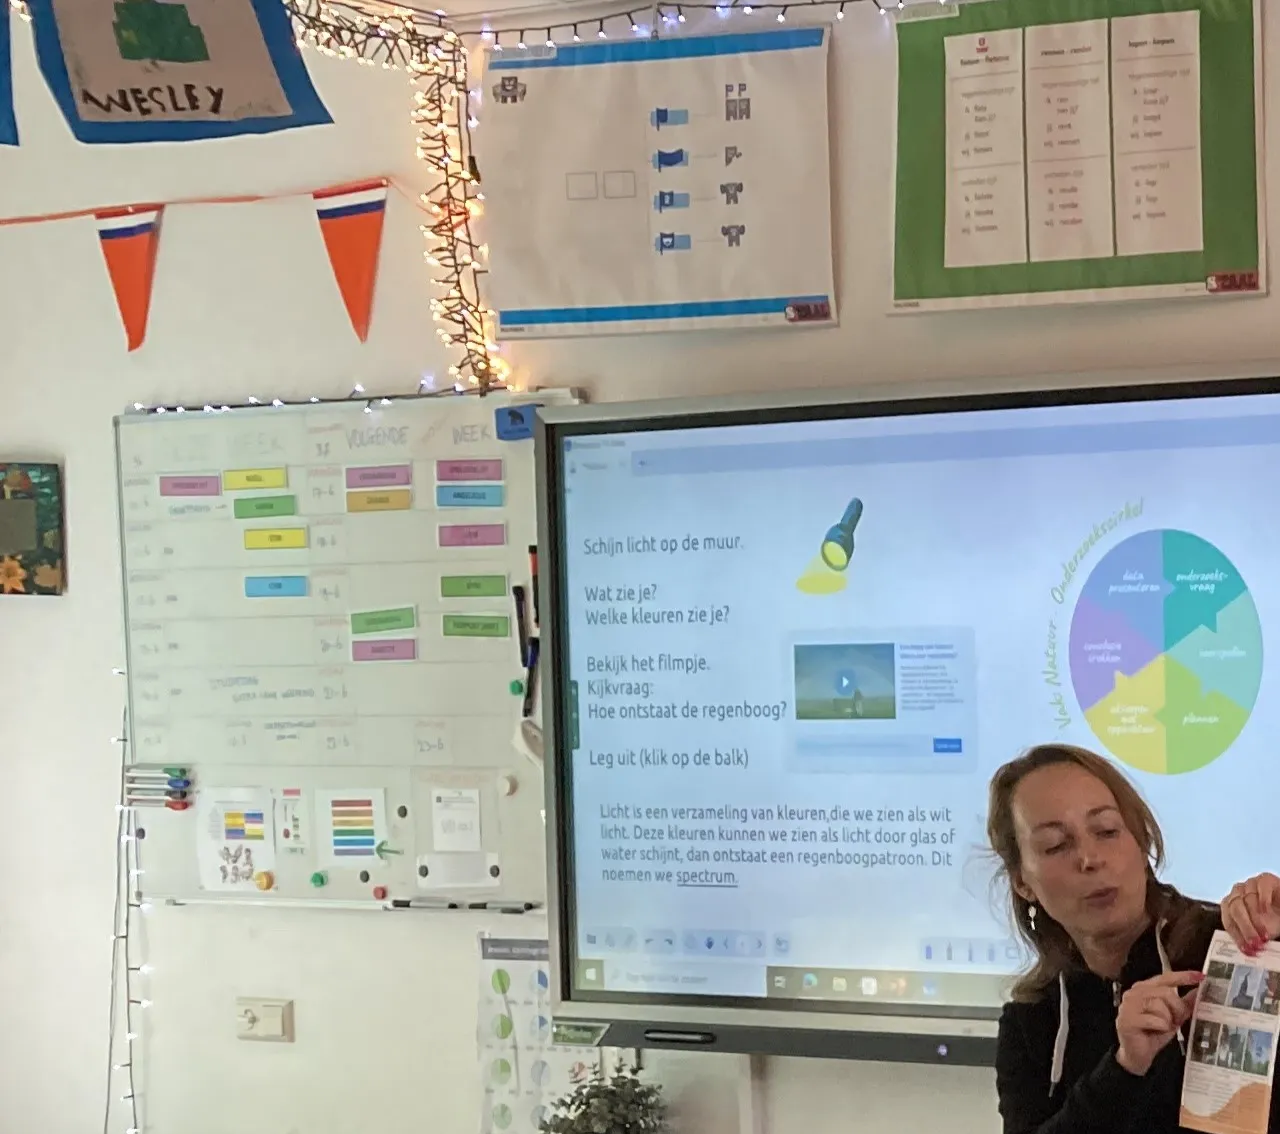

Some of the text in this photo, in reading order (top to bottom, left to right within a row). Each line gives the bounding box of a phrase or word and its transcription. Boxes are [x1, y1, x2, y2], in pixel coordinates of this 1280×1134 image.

[81, 83, 224, 116] WESLEY
[453, 424, 492, 445] WEEK
[584, 533, 744, 557] Schijn licht op de muur.
[585, 584, 657, 603] Wat zie je?
[586, 605, 729, 625] Welke kleuren zie je?
[587, 654, 711, 675] Bekijk het filmpje.
[588, 679, 654, 699] Kijkvraag:
[588, 700, 787, 721] Hoe ontstaat de regenboog?
[589, 748, 749, 768] Leg uit (klik op de balk)
[600, 804, 630, 819] Licht
[633, 805, 642, 819] is
[646, 807, 668, 819] een
[672, 805, 747, 823] verzameling
[751, 807, 773, 820] van
[854, 809, 873, 821] we
[877, 807, 904, 821] zien
[908, 805, 926, 822] als
[930, 807, 952, 822] wit
[601, 824, 956, 847] licht. Deze kleuren kunnen we zien als licht door glas of
[602, 846, 952, 868] water schijnt, dan ontstaat een regenboogpatroon. Dit
[602, 869, 739, 886] noemen we spectrum.
